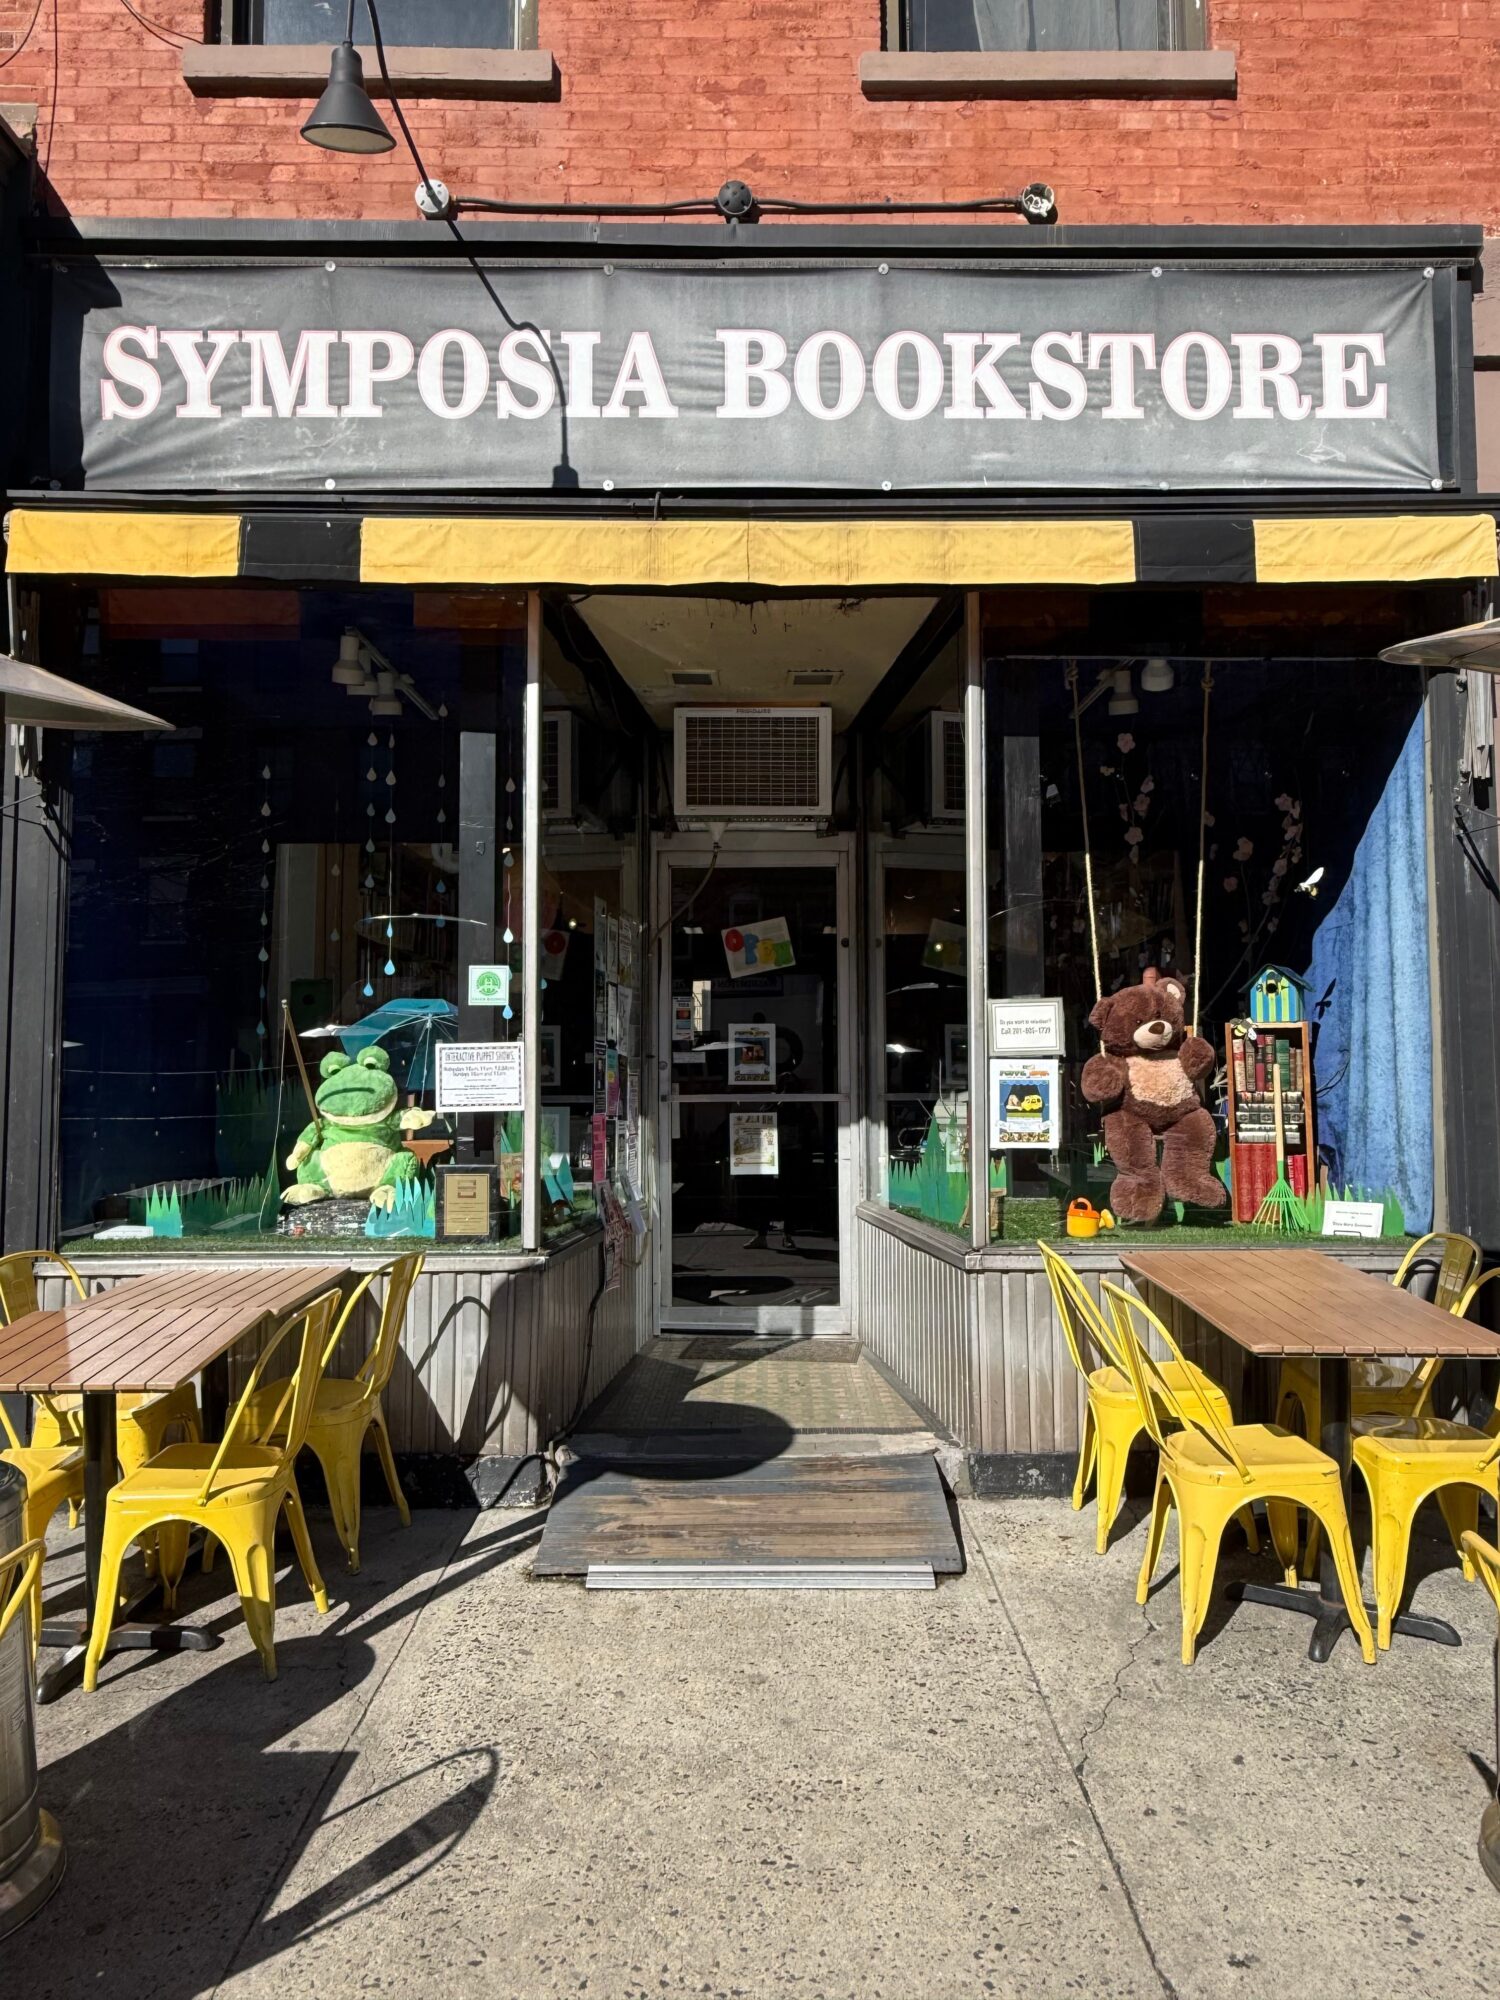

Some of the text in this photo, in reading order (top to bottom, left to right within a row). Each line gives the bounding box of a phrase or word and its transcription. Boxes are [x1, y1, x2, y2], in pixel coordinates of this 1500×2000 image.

[101, 325, 1388, 421] SYMPOSIA BOOKSTORE
[445, 1051, 475, 1062] INTERACTIVE
[476, 1051, 494, 1061] PUPPET
